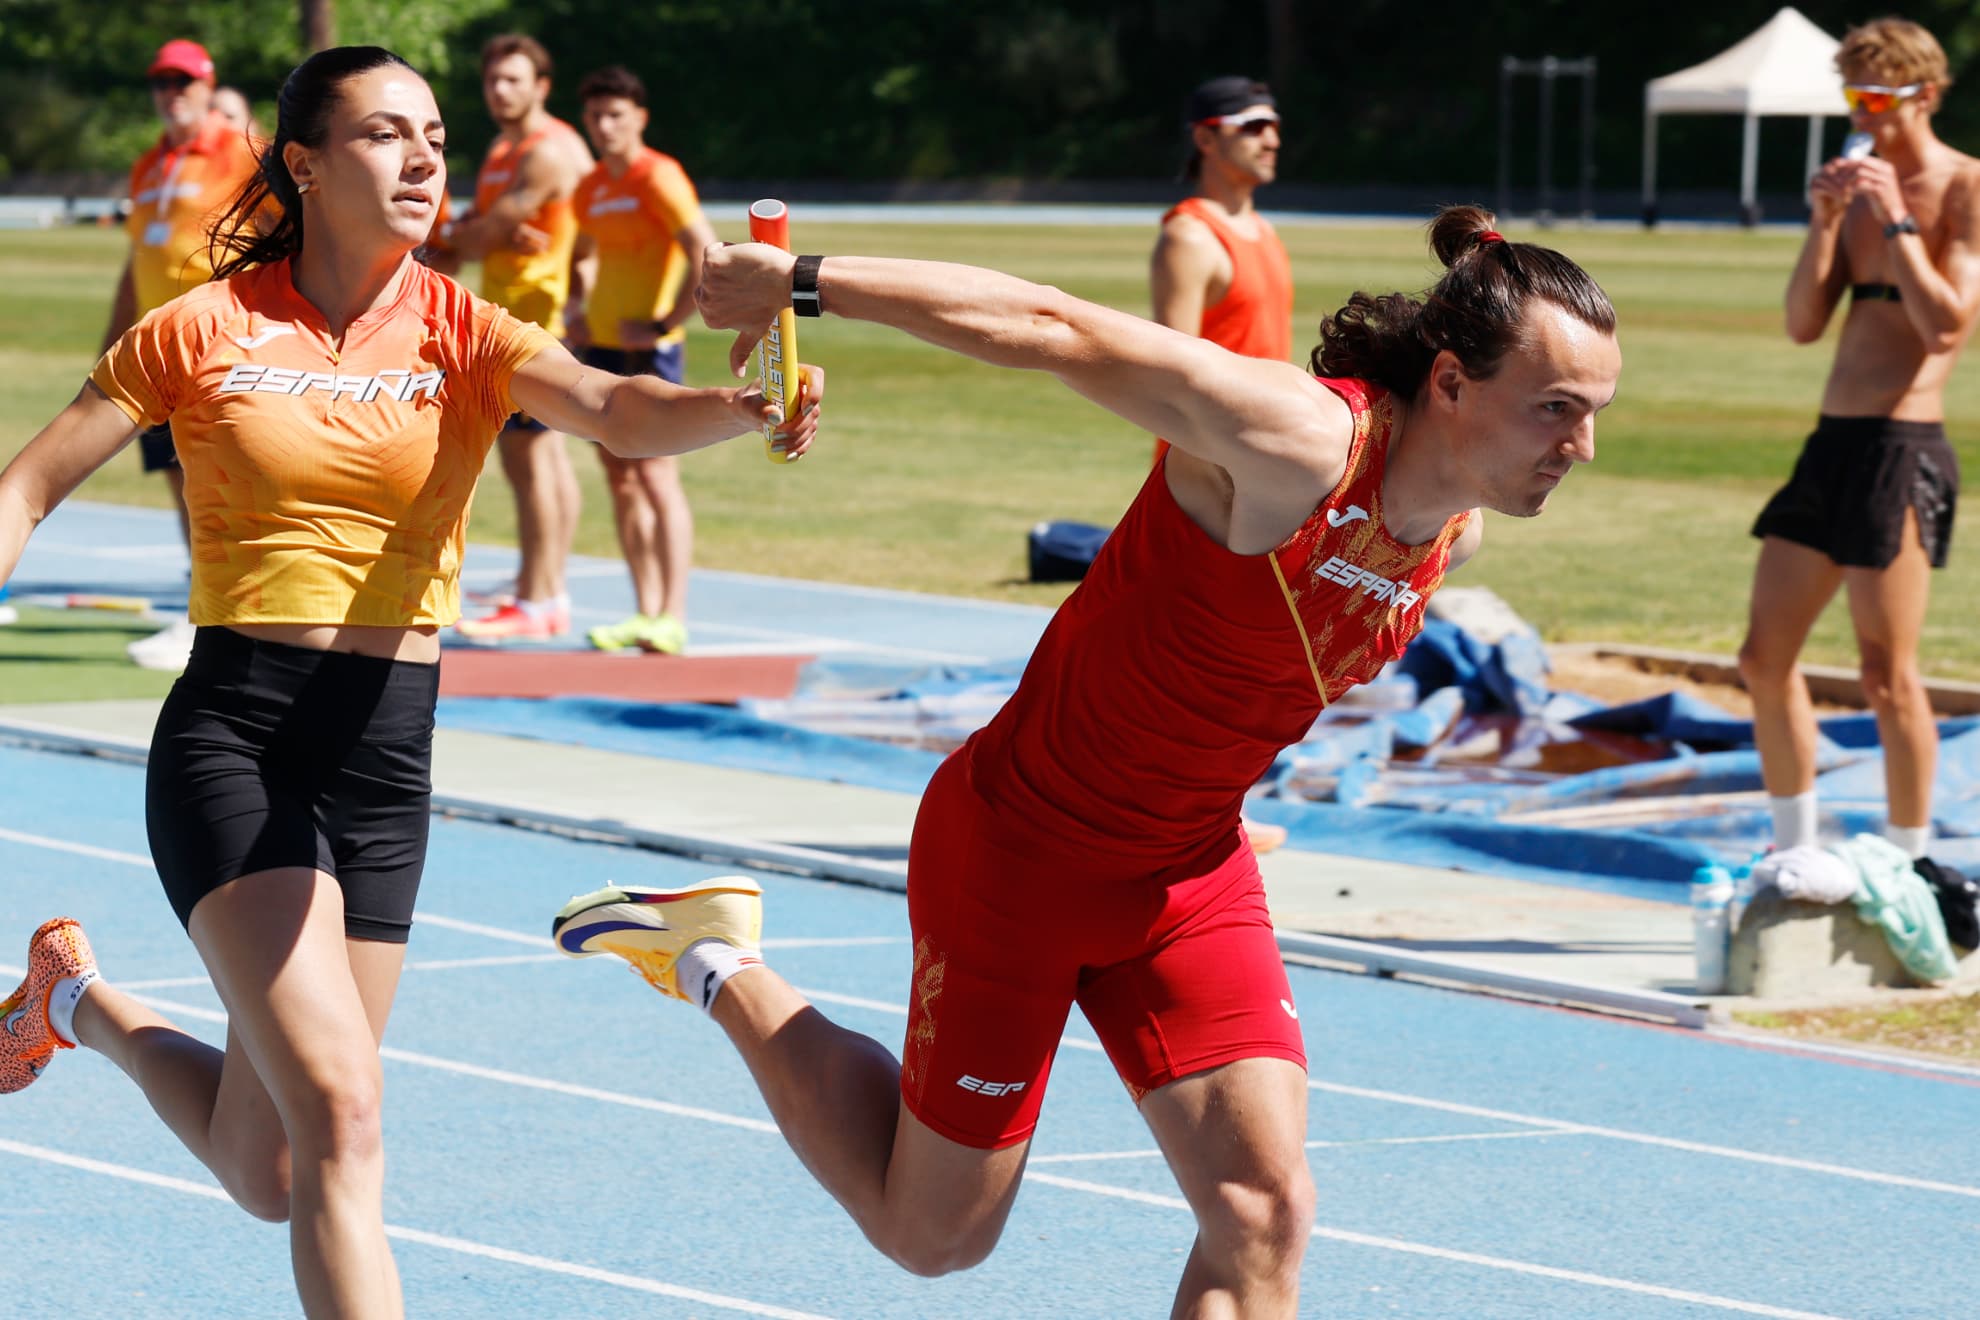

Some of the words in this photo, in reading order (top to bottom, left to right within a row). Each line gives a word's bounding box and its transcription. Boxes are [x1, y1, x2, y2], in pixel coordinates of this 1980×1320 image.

[219, 363, 447, 402] ESPAÑA
[1315, 555, 1421, 614] ESPAÑA
[956, 1074, 1027, 1097] ESP
